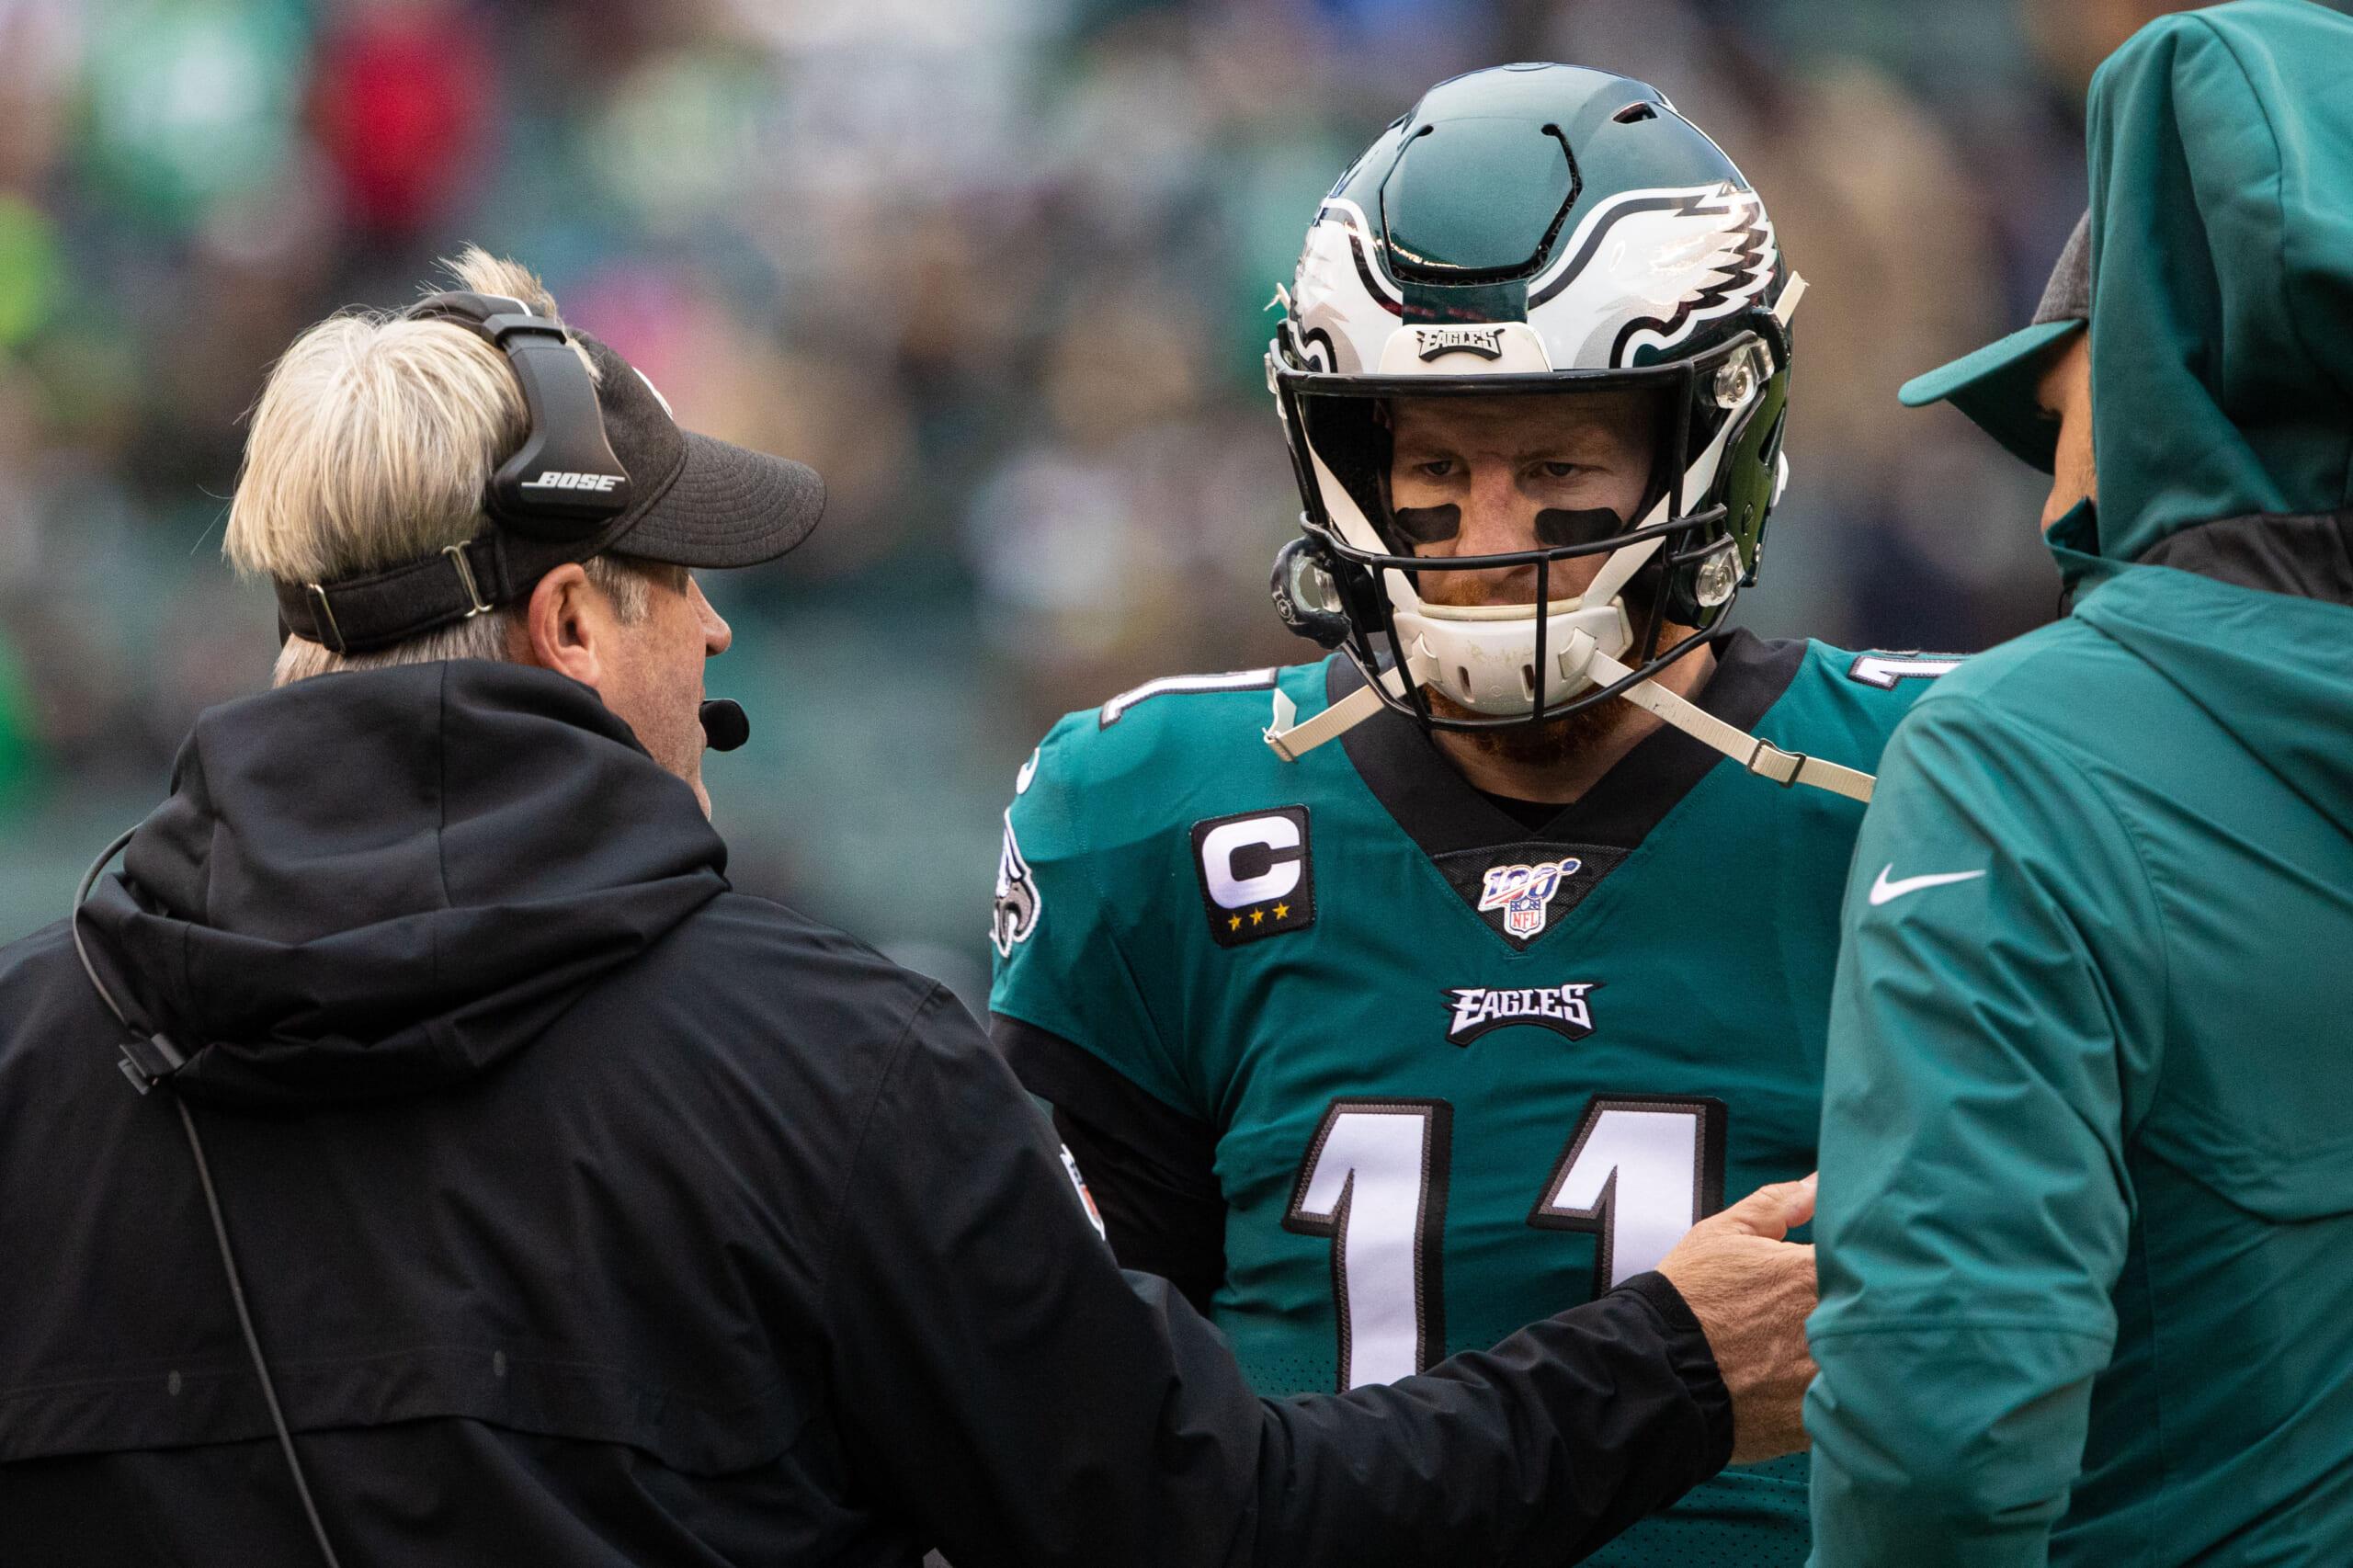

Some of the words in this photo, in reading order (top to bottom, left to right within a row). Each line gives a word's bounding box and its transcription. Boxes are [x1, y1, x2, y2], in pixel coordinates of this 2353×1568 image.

[1416, 328, 1505, 360] EAGLES
[521, 471, 626, 492] BOSE
[1201, 815, 1302, 909] C
[1512, 911, 1538, 928] NFL
[1449, 982, 1597, 1037] EAGLES
[1283, 1096, 1726, 1392] 11
